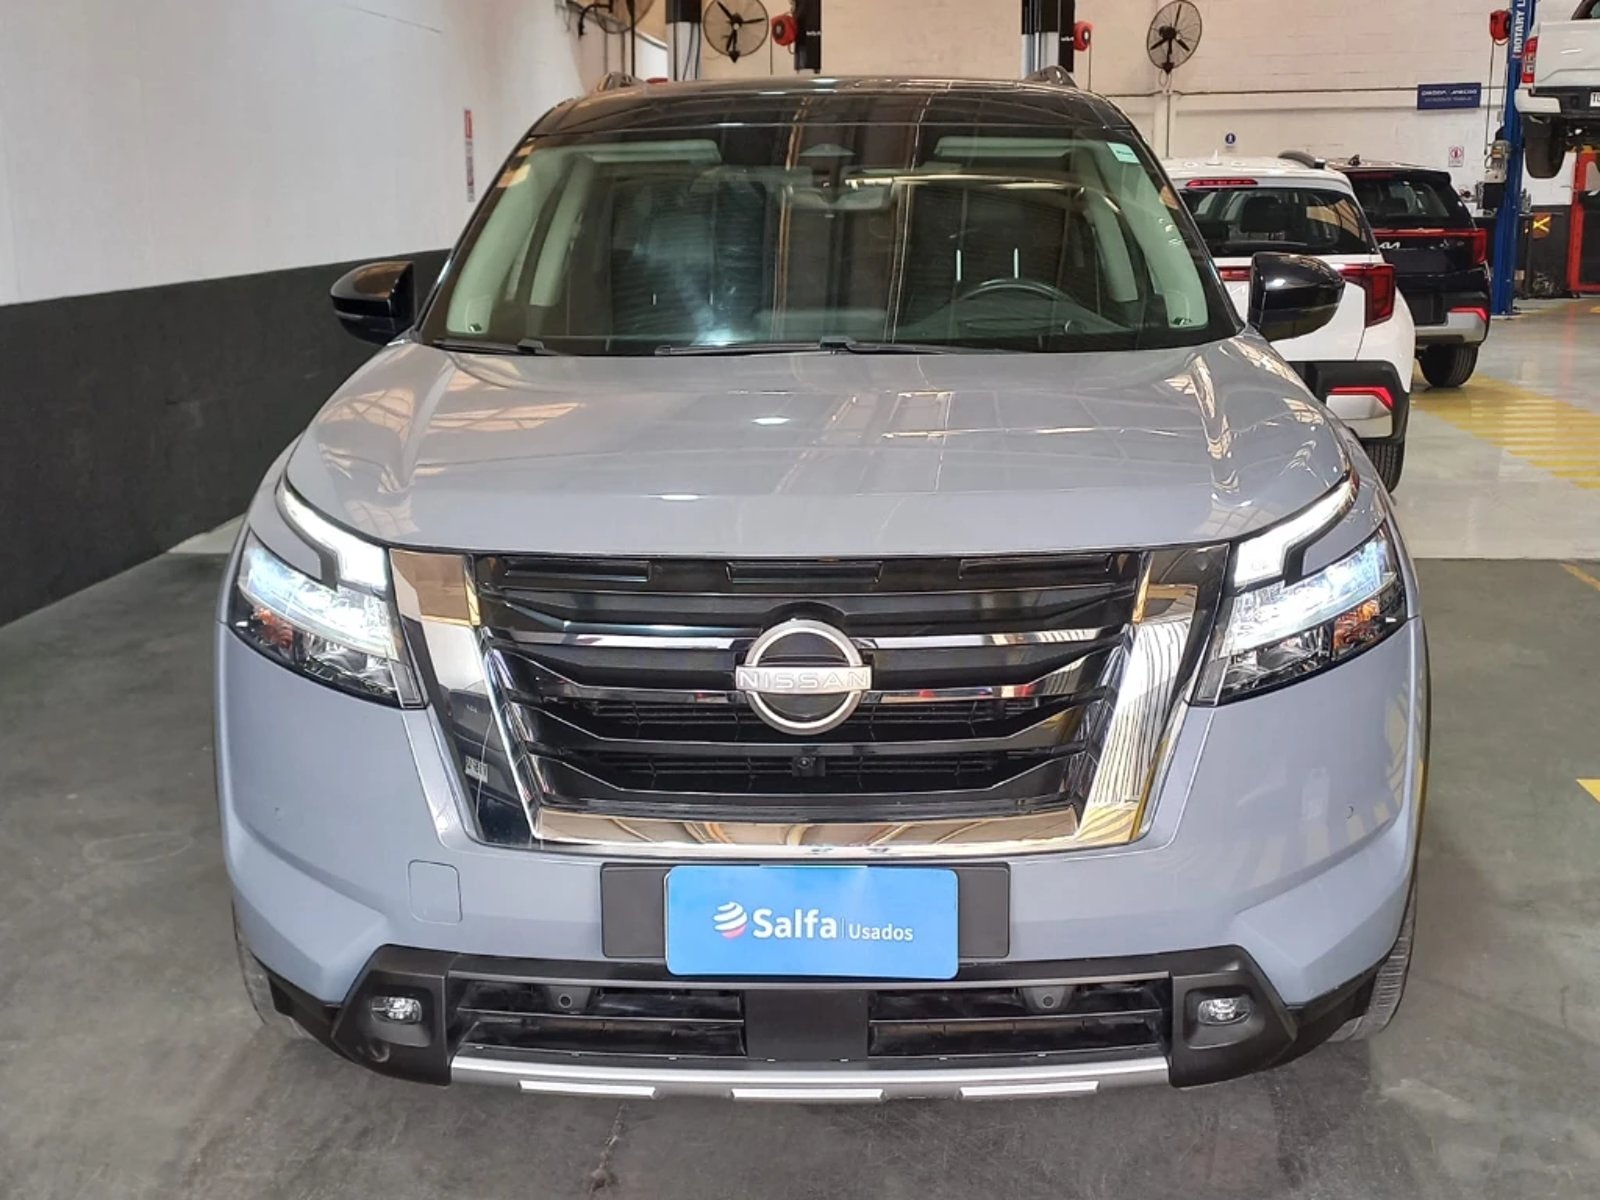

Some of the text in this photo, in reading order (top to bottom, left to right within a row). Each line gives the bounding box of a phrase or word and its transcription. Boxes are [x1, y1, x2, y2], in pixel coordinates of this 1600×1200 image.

[1513, 10, 1525, 53] ROTARY
[738, 669, 868, 689] NISSAN
[752, 908, 914, 941] Salfa Usados
